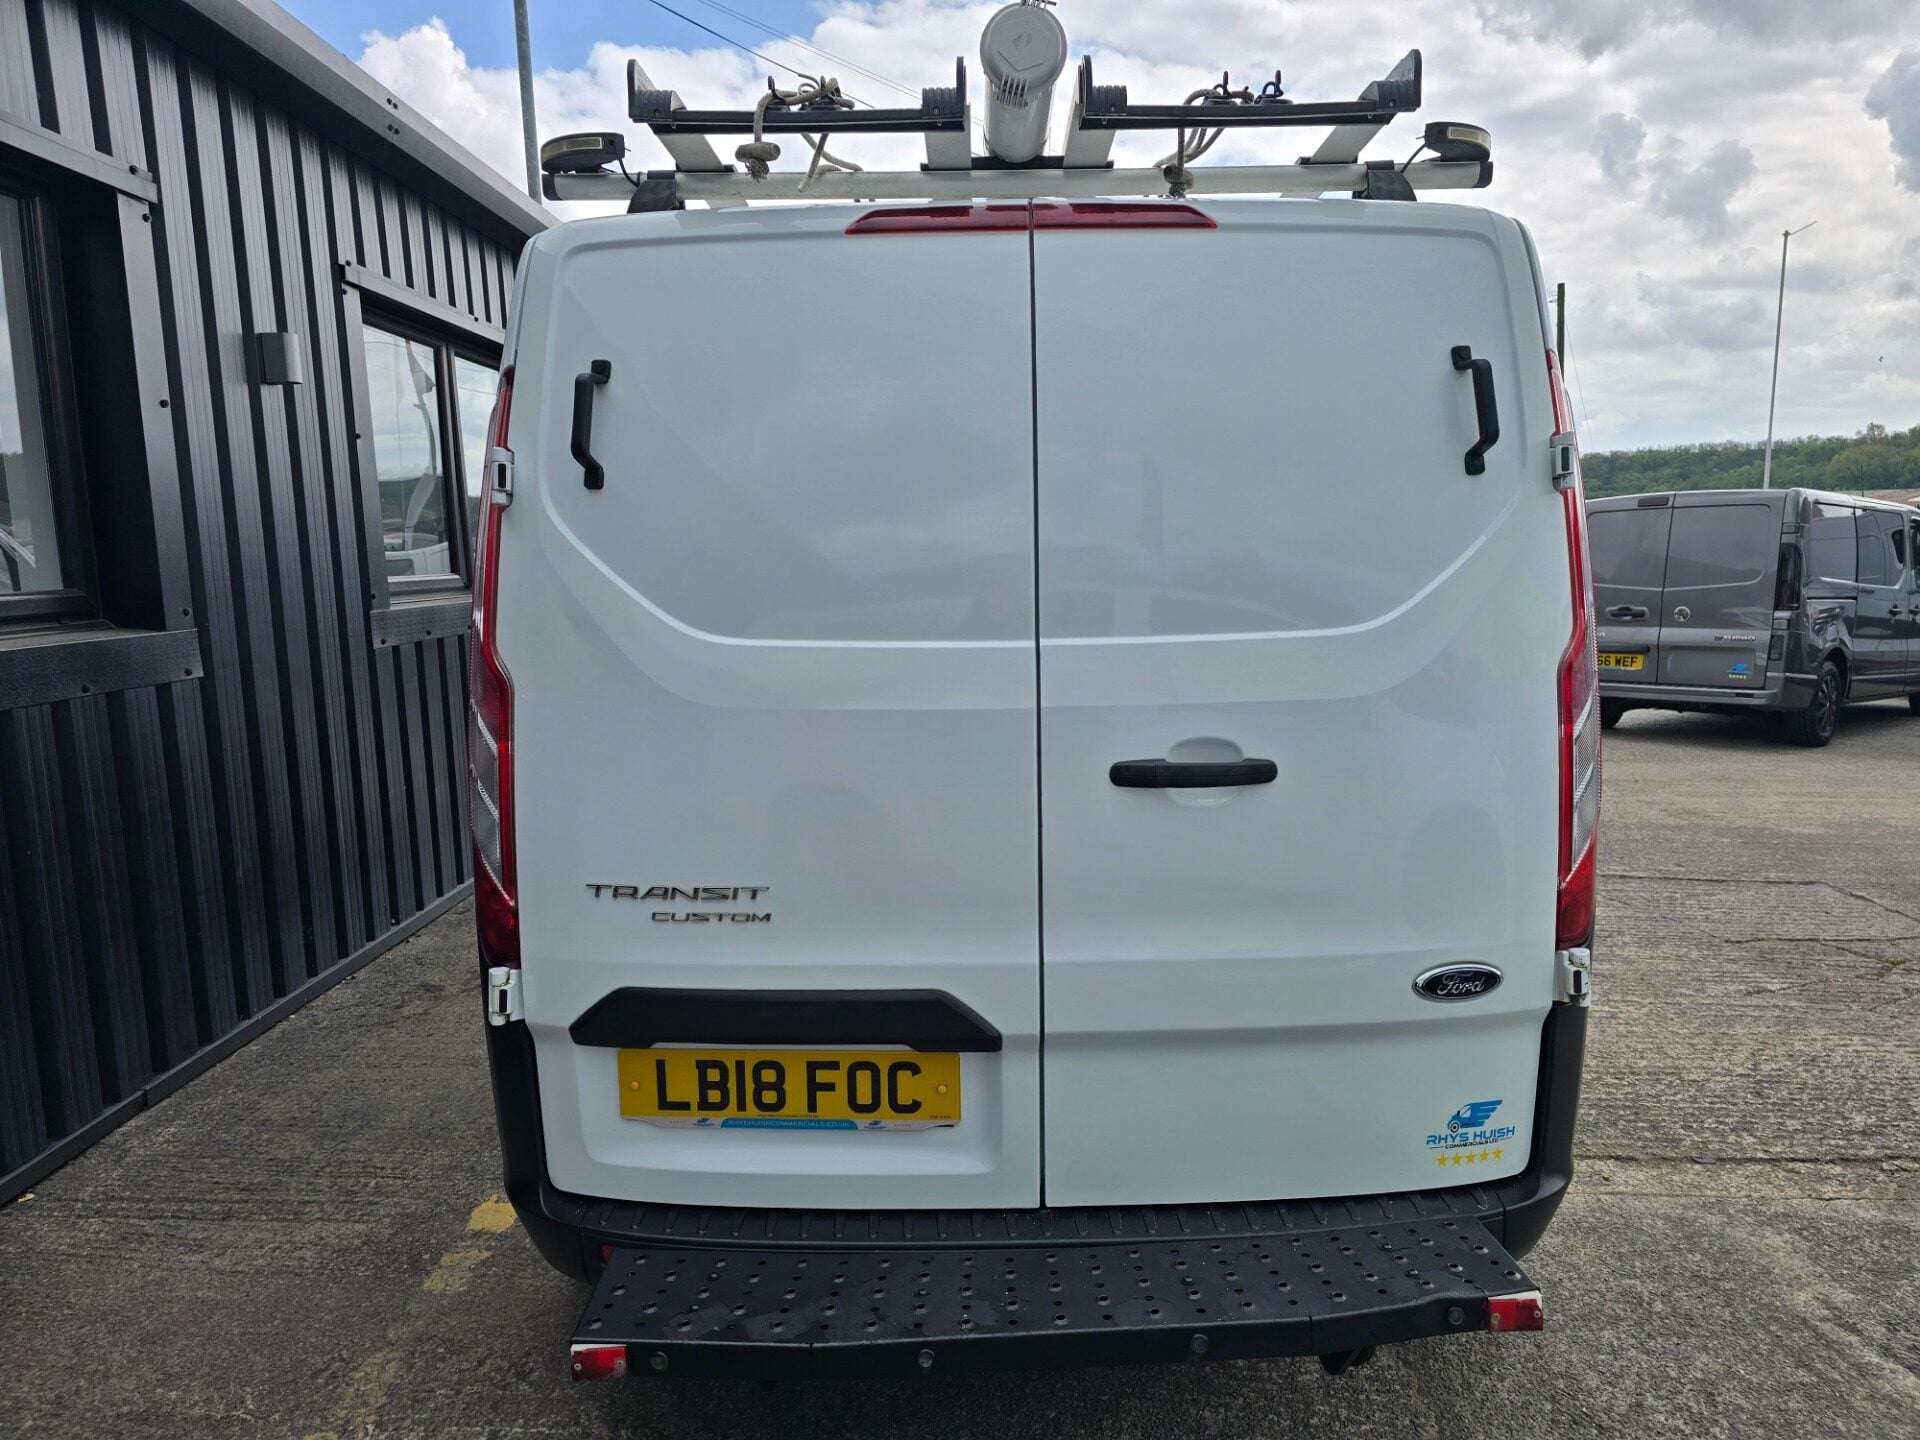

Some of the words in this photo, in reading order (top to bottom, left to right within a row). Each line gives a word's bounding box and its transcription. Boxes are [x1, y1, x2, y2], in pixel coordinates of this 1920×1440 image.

[1614, 656, 1638, 667] WEF
[585, 884, 770, 900] TRANSIT
[651, 912, 772, 922] CUSTOM
[1437, 972, 1485, 995] Ford
[656, 1059, 786, 1112] LB18
[806, 1060, 923, 1114] FOC
[1426, 1132, 1469, 1145] RHYS
[1473, 1126, 1515, 1141] HUISH
